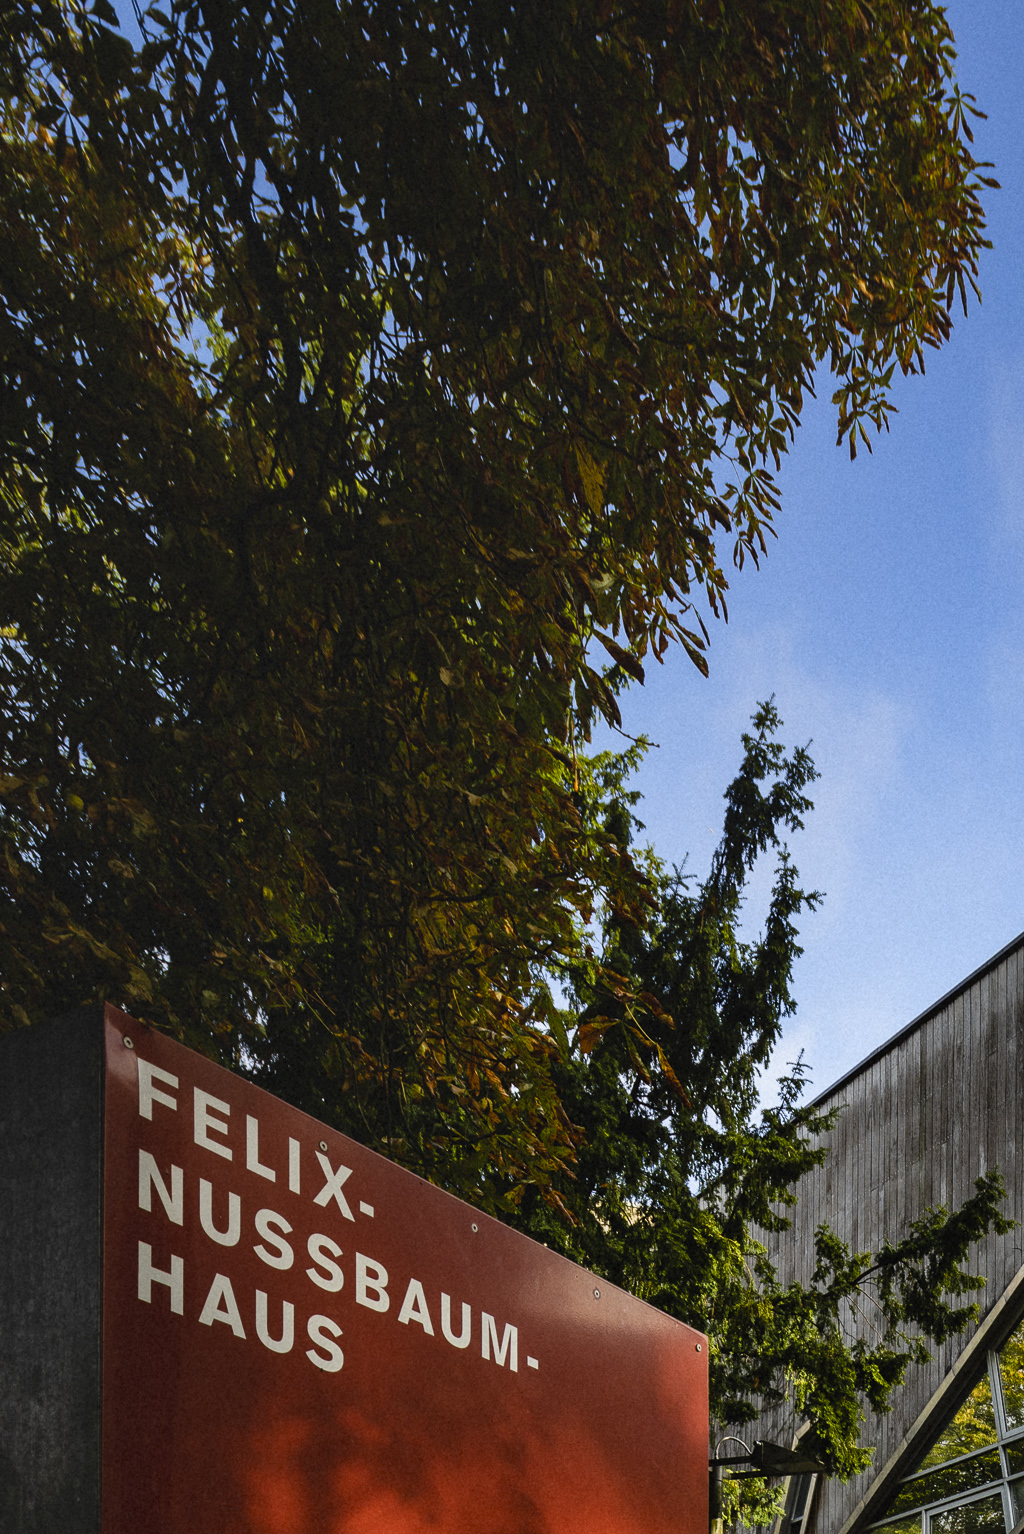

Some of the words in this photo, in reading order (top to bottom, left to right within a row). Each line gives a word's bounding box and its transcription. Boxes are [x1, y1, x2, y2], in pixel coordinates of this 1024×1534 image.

[136, 1056, 375, 1223] FELIX-
[137, 1148, 540, 1373] NUSSBAUM-
[137, 1240, 345, 1373] HAUS
